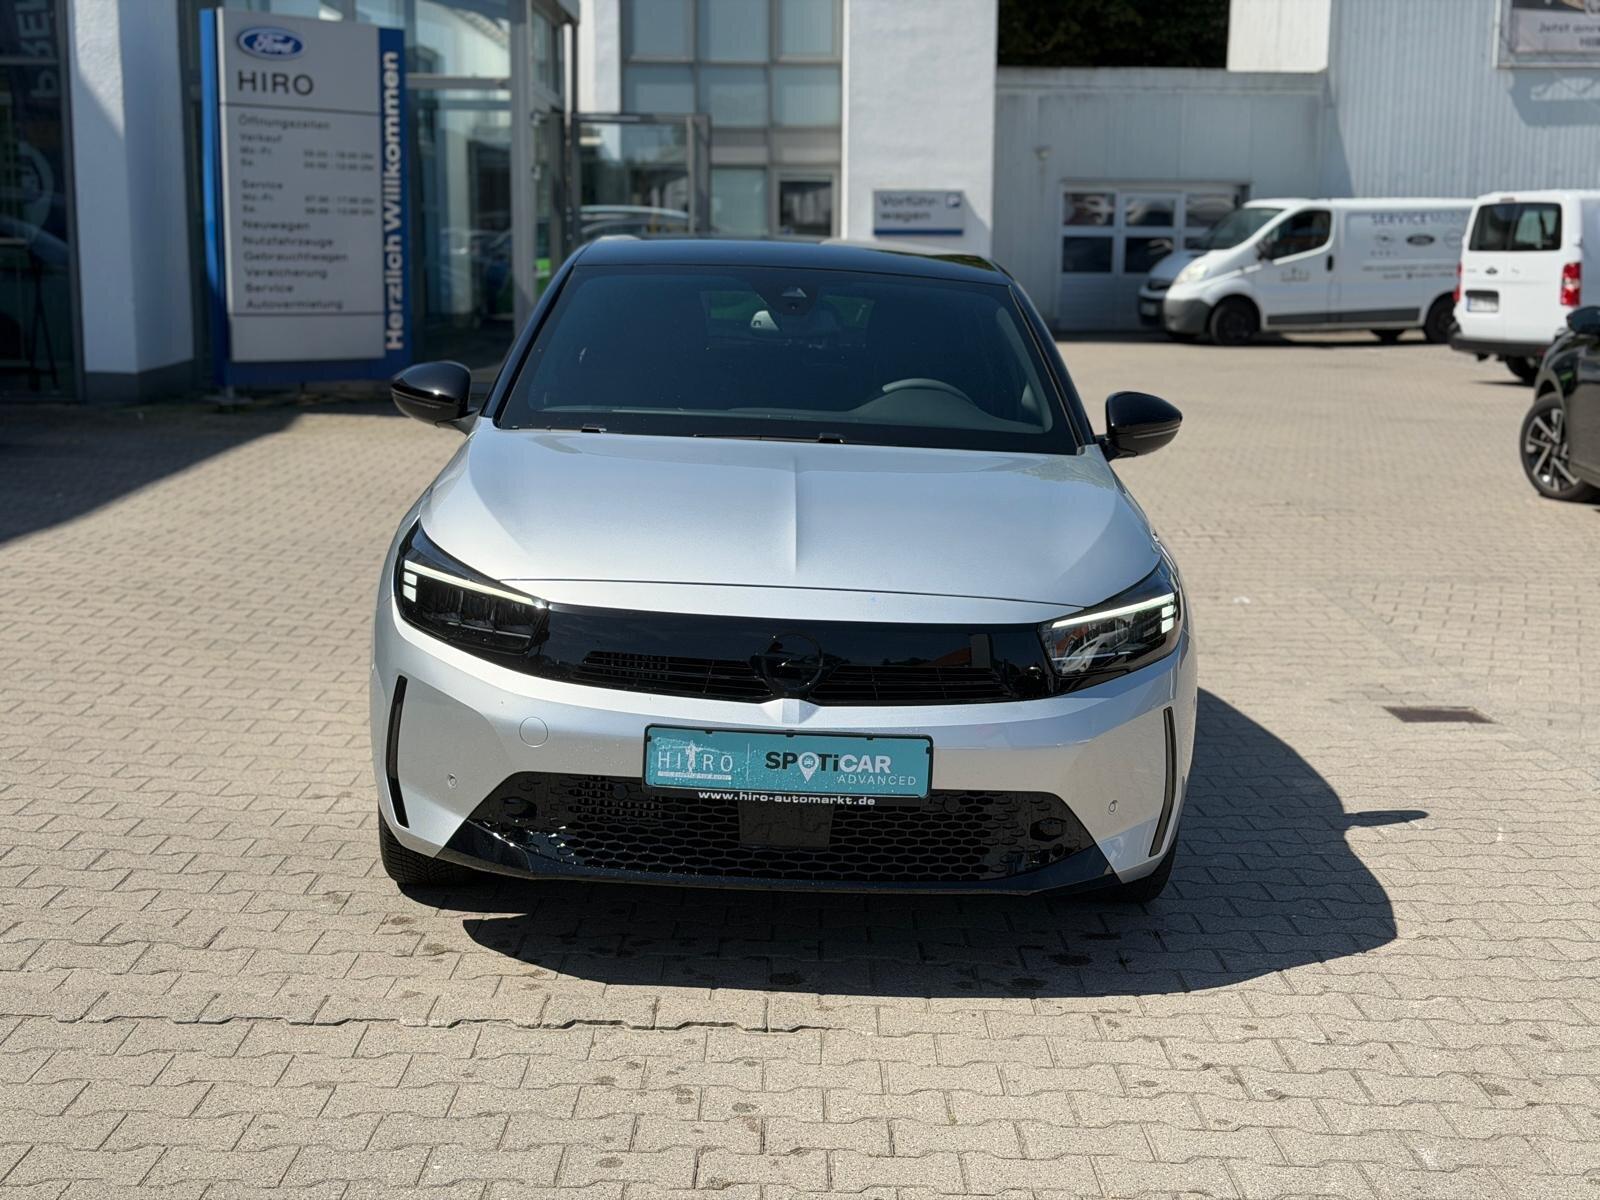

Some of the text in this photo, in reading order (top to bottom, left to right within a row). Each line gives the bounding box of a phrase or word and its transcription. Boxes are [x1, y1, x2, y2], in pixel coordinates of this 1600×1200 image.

[238, 70, 314, 96] HIRO
[382, 51, 404, 350] Herzlich Willkommen
[657, 750, 734, 773] HIRO
[837, 774, 917, 786] ADVANCED
[697, 790, 876, 806] www.hiro-automarkt.de
